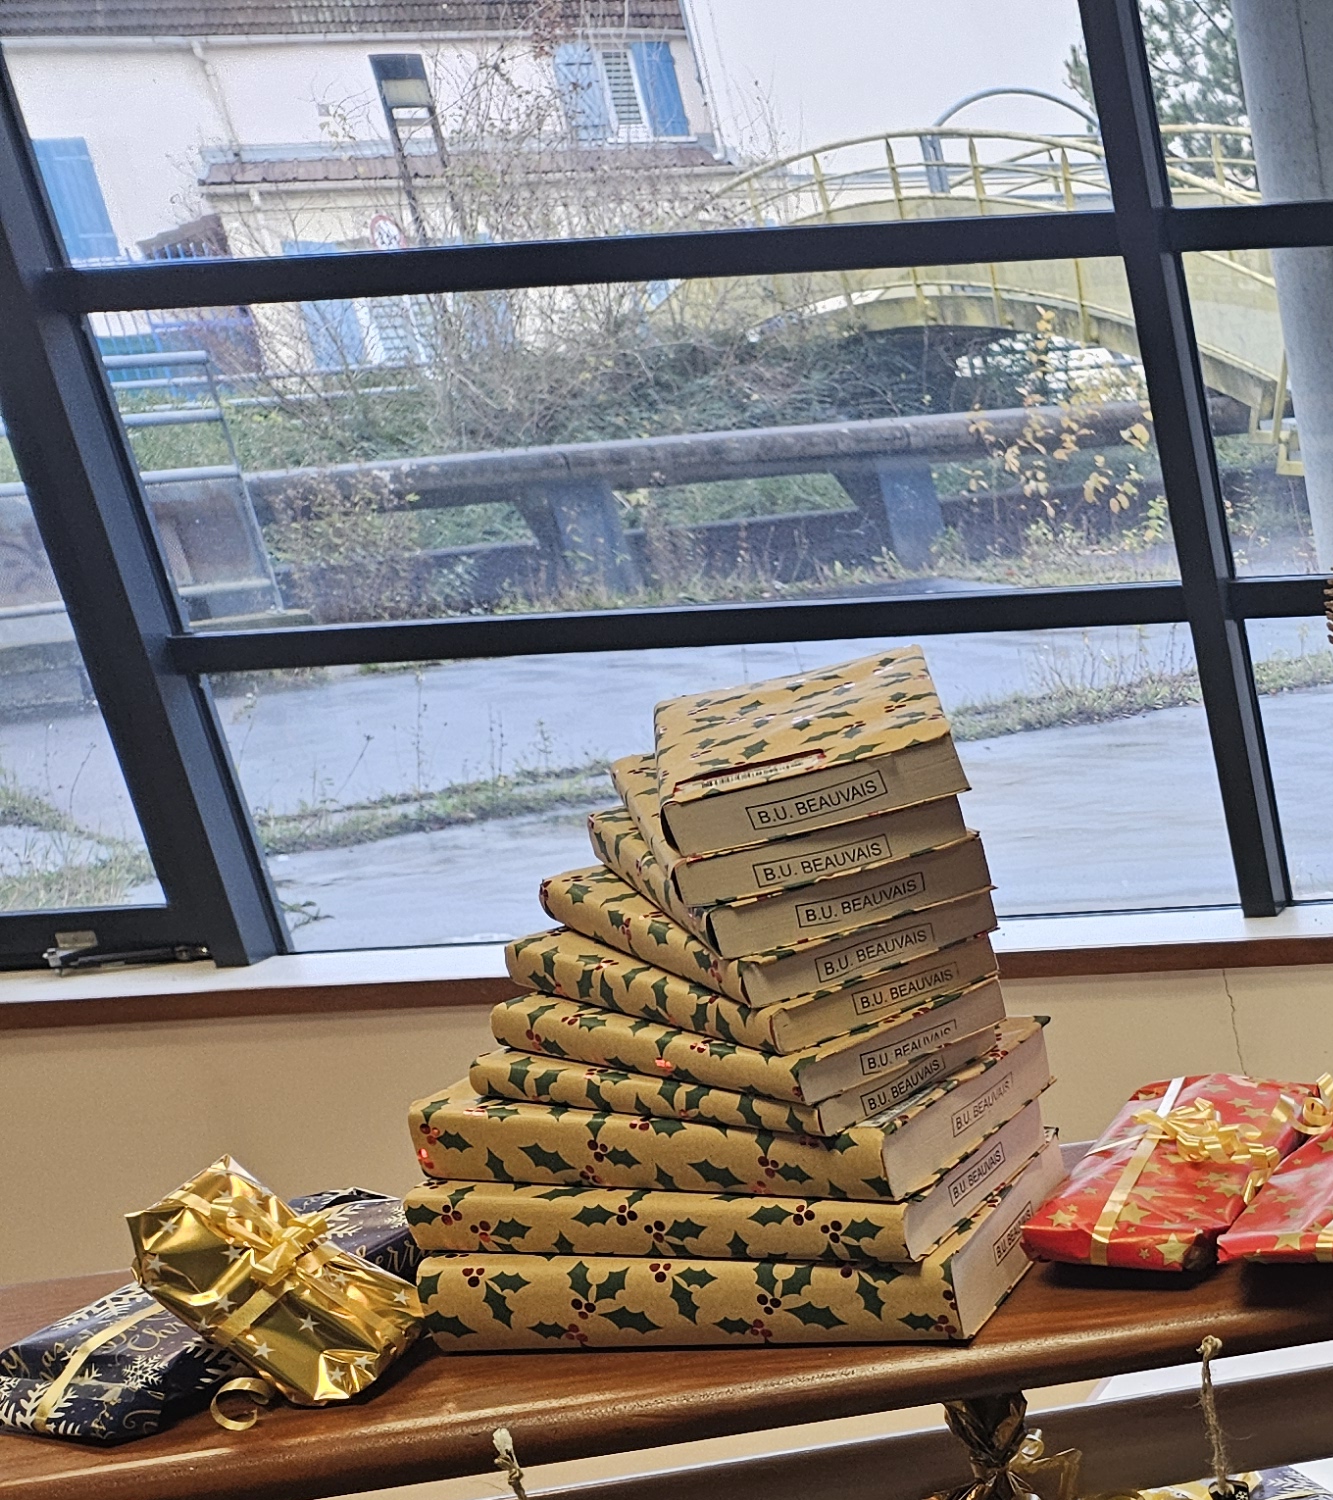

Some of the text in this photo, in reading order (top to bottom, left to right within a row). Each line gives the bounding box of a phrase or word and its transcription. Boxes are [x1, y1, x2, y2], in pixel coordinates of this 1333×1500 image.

[757, 780, 877, 825] B.U. BEAUVAIS
[763, 842, 882, 882] B.U. BEAUVAIS
[804, 879, 917, 922] B.U. BEAUVAIS
[823, 929, 927, 976] B.U. BEAUVAIS
[859, 969, 953, 1009] B.U. BEAUVAIS
[867, 1052, 893, 1070] B.U.
[867, 1091, 890, 1110] B.U.
[891, 1059, 940, 1099] BEAUVAIS
[954, 1080, 1011, 1131] B.U. BEAUVAIS
[952, 1150, 1002, 1198] B.U. BEAUVAIS
